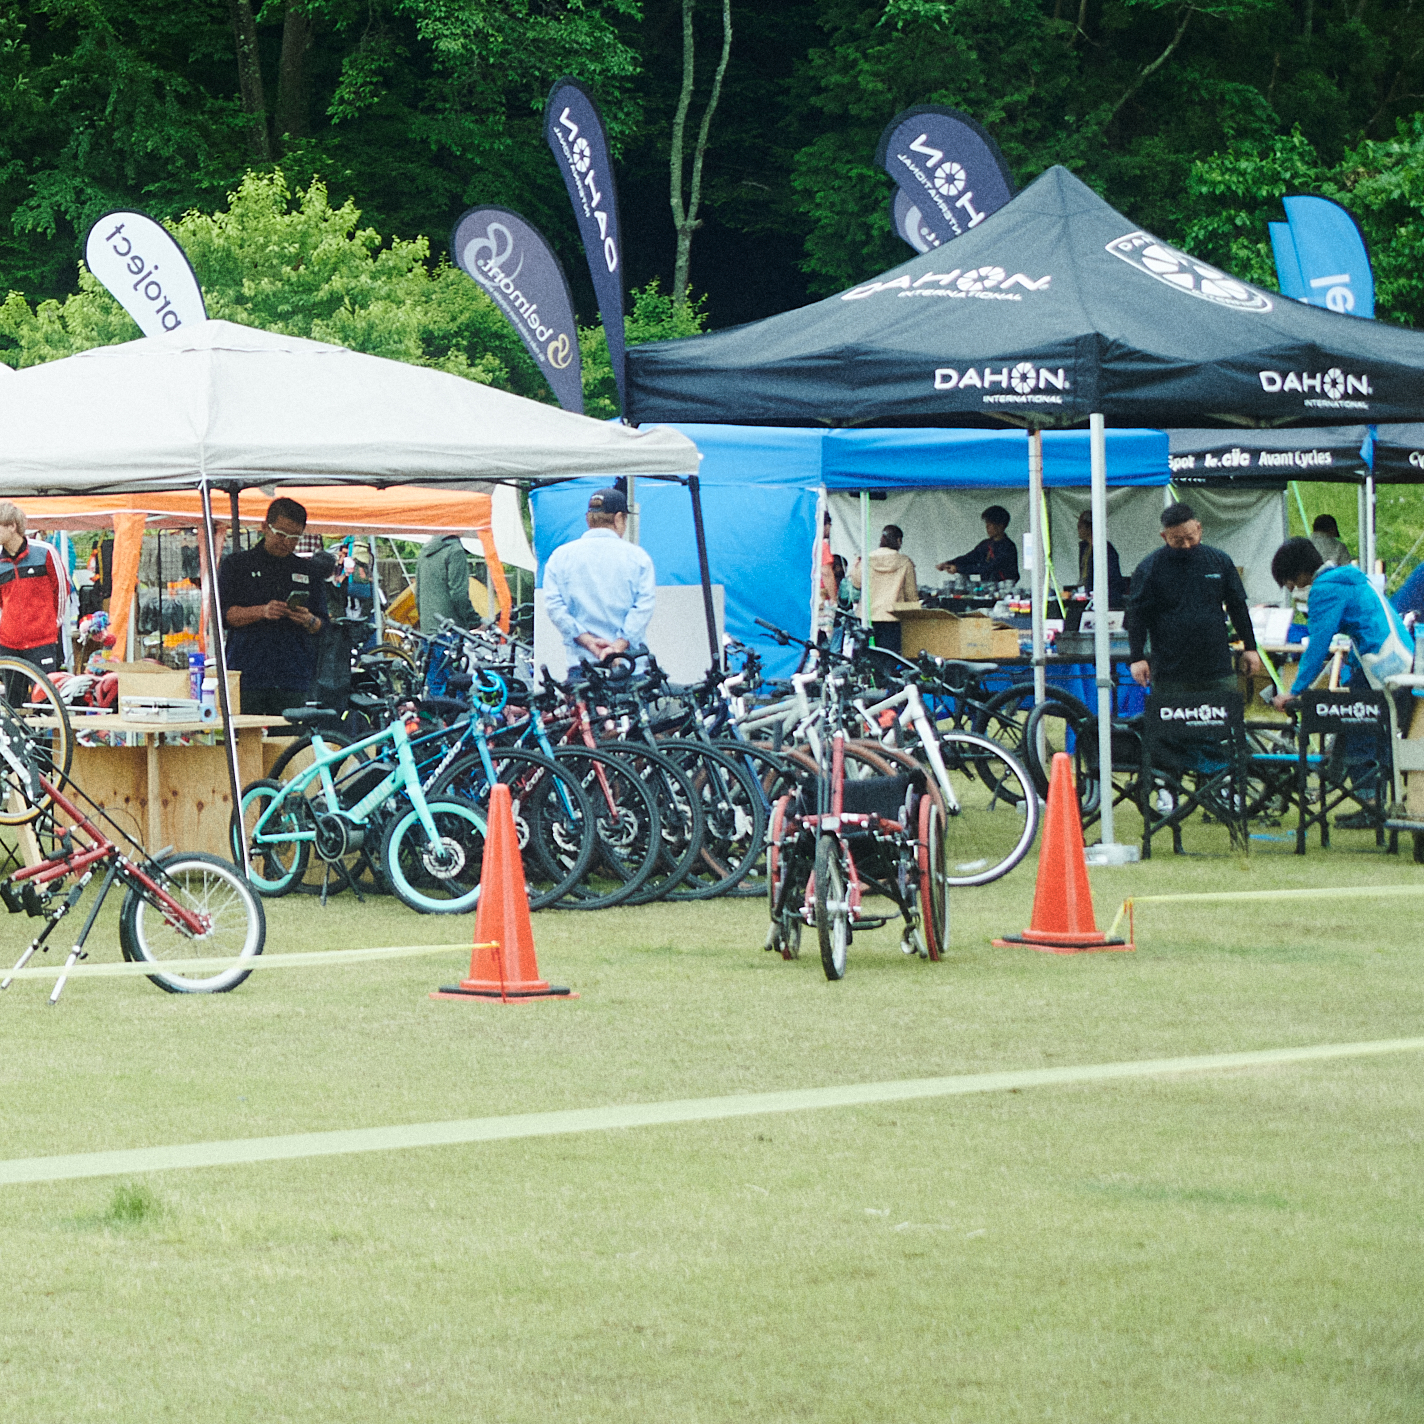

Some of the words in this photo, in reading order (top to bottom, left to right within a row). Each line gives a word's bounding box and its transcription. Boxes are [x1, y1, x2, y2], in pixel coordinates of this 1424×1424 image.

[841, 266, 1052, 301] DAHON
[897, 289, 1023, 302] INTERNATIONAL
[934, 362, 1065, 394] DAHON
[1258, 368, 1369, 400] DAHON
[983, 394, 1063, 405] INTERNATIONAL
[1303, 399, 1370, 410] INTERNATIONAL
[1160, 704, 1225, 721] DAHON
[1316, 702, 1379, 718] DAHON
